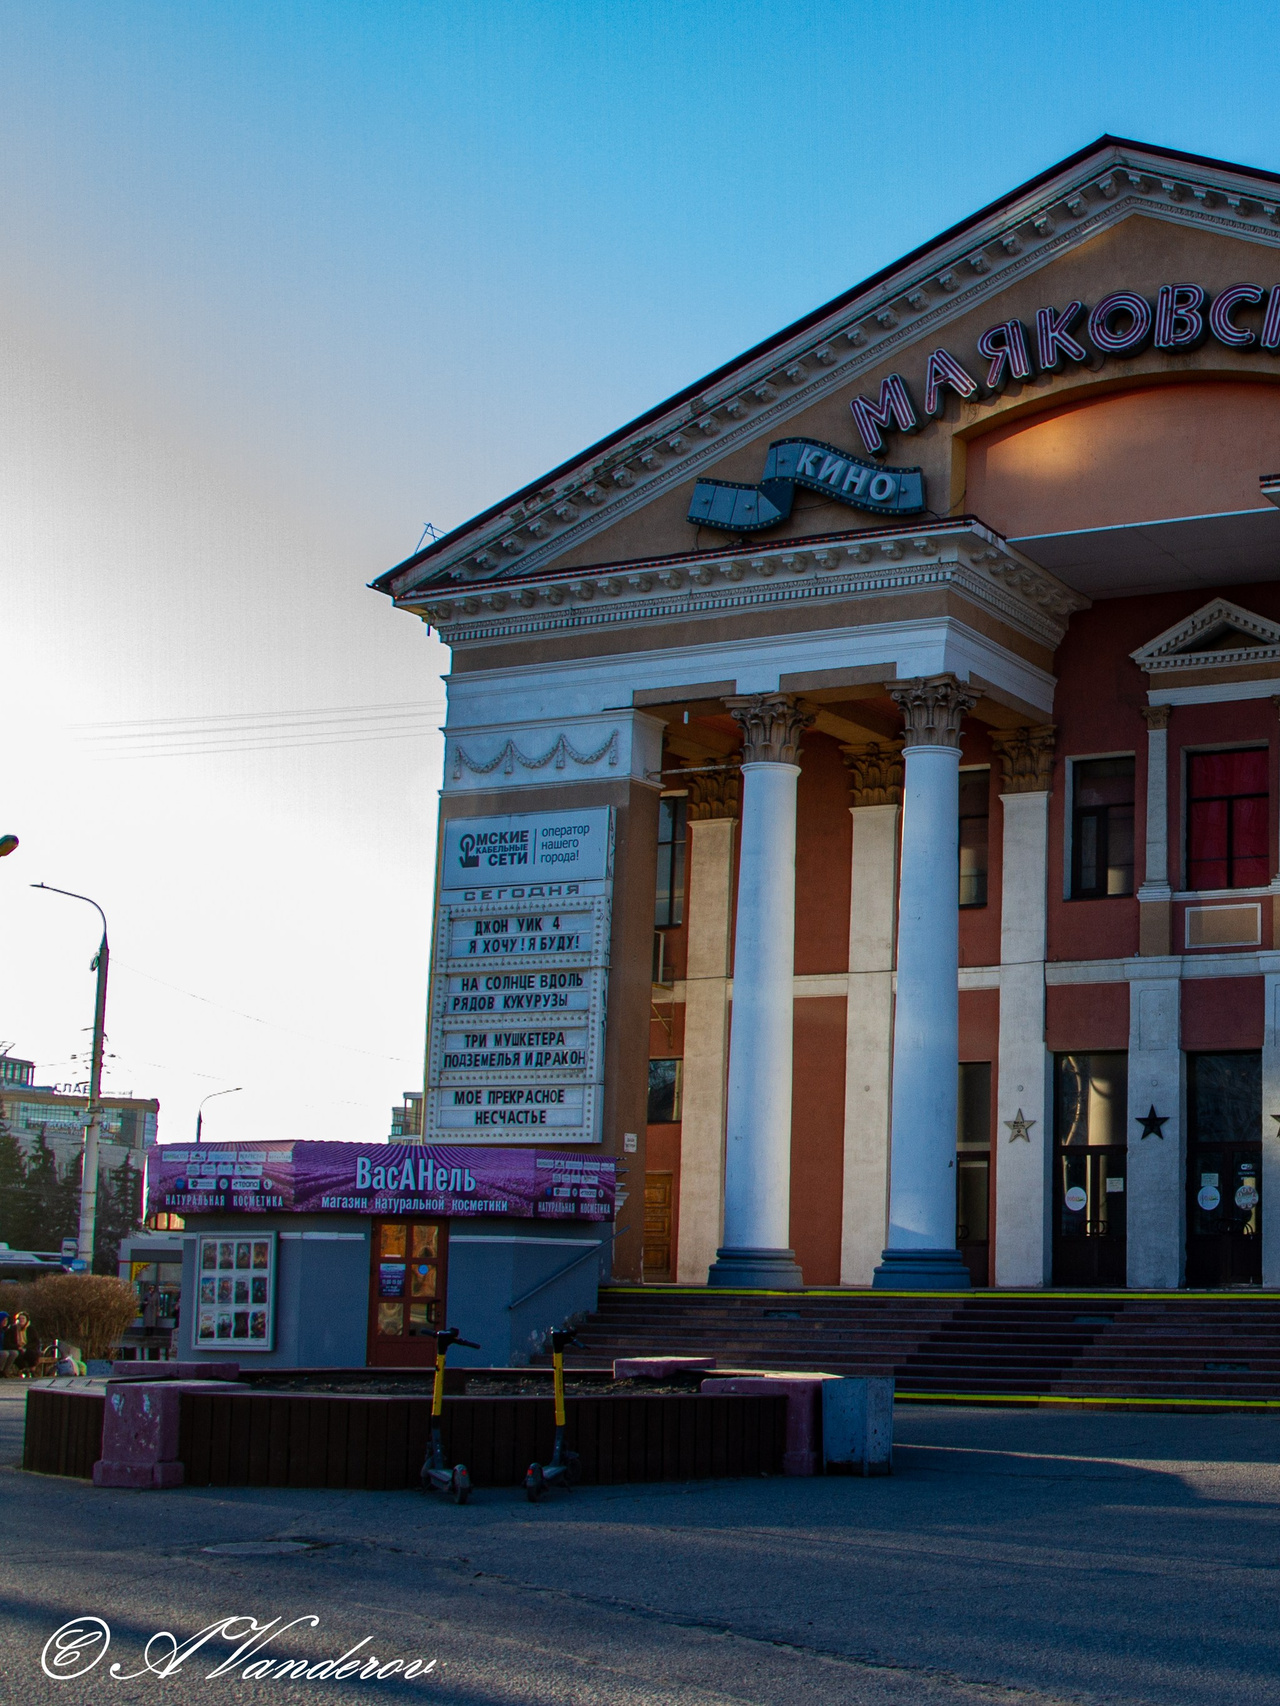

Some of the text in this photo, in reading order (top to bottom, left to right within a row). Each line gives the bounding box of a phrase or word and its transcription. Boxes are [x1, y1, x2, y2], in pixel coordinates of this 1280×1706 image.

[796, 447, 897, 501] КИНО
[541, 825, 590, 839] оператор
[475, 843, 529, 854] КАБЕЛЬНЫЕ
[541, 839, 580, 850] нашего
[488, 852, 528, 867] СЕТИ
[541, 850, 580, 864] города!
[464, 884, 580, 901] СЕГОДНЯ
[475, 916, 561, 936] ДЖОН УИК 4
[469, 940, 477, 954] Я
[528, 937, 536, 951] Я
[540, 935, 580, 951] БУДУ!
[461, 973, 584, 992] НА СОЛНЦЕ ВДОЛЬ
[453, 993, 568, 1012] РЯДОВ КУКУРУЗЫ
[465, 1031, 566, 1048] ТРИ МУШКЕТЕРА
[444, 1050, 586, 1068] ПОДЗЕМЕЛЬЯ И ДРАКОН
[454, 1089, 565, 1104] МОЁ ПРЕКРАСНОЕ
[475, 1110, 547, 1125] НЕСЧАСТЬЕ
[355, 1156, 476, 1192] ВасАНель
[165, 1194, 283, 1207] НАТУРАЛЬНАЯ КОСМЕТИКА
[321, 1196, 508, 1213] магазин натуральной косметики
